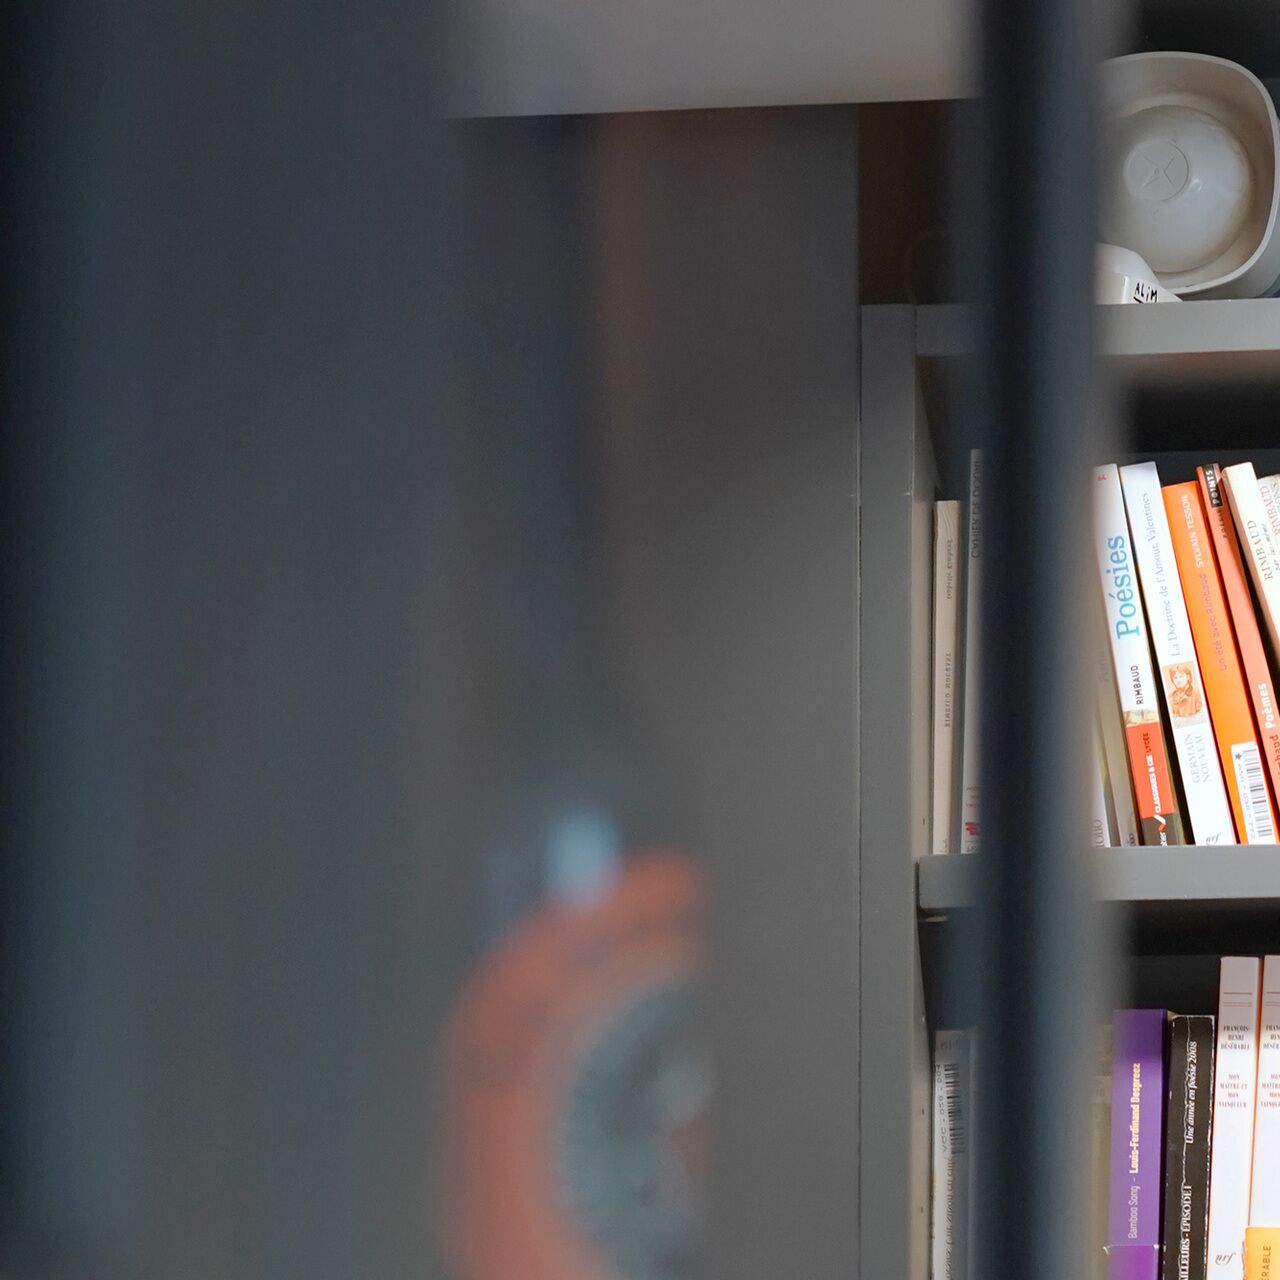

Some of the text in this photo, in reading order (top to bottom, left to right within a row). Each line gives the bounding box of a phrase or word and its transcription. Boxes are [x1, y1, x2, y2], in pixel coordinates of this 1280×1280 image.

[1206, 469, 1219, 505] POINTS
[1181, 495, 1204, 568] SYLVAIN TESSON
[1107, 535, 1140, 639] Poésies
[1130, 664, 1144, 705] RIMBAUD
[1260, 683, 1278, 729] Poèmes
[1127, 1062, 1141, 1239] Bamboo Song Louis-Ferdinand Despreez
